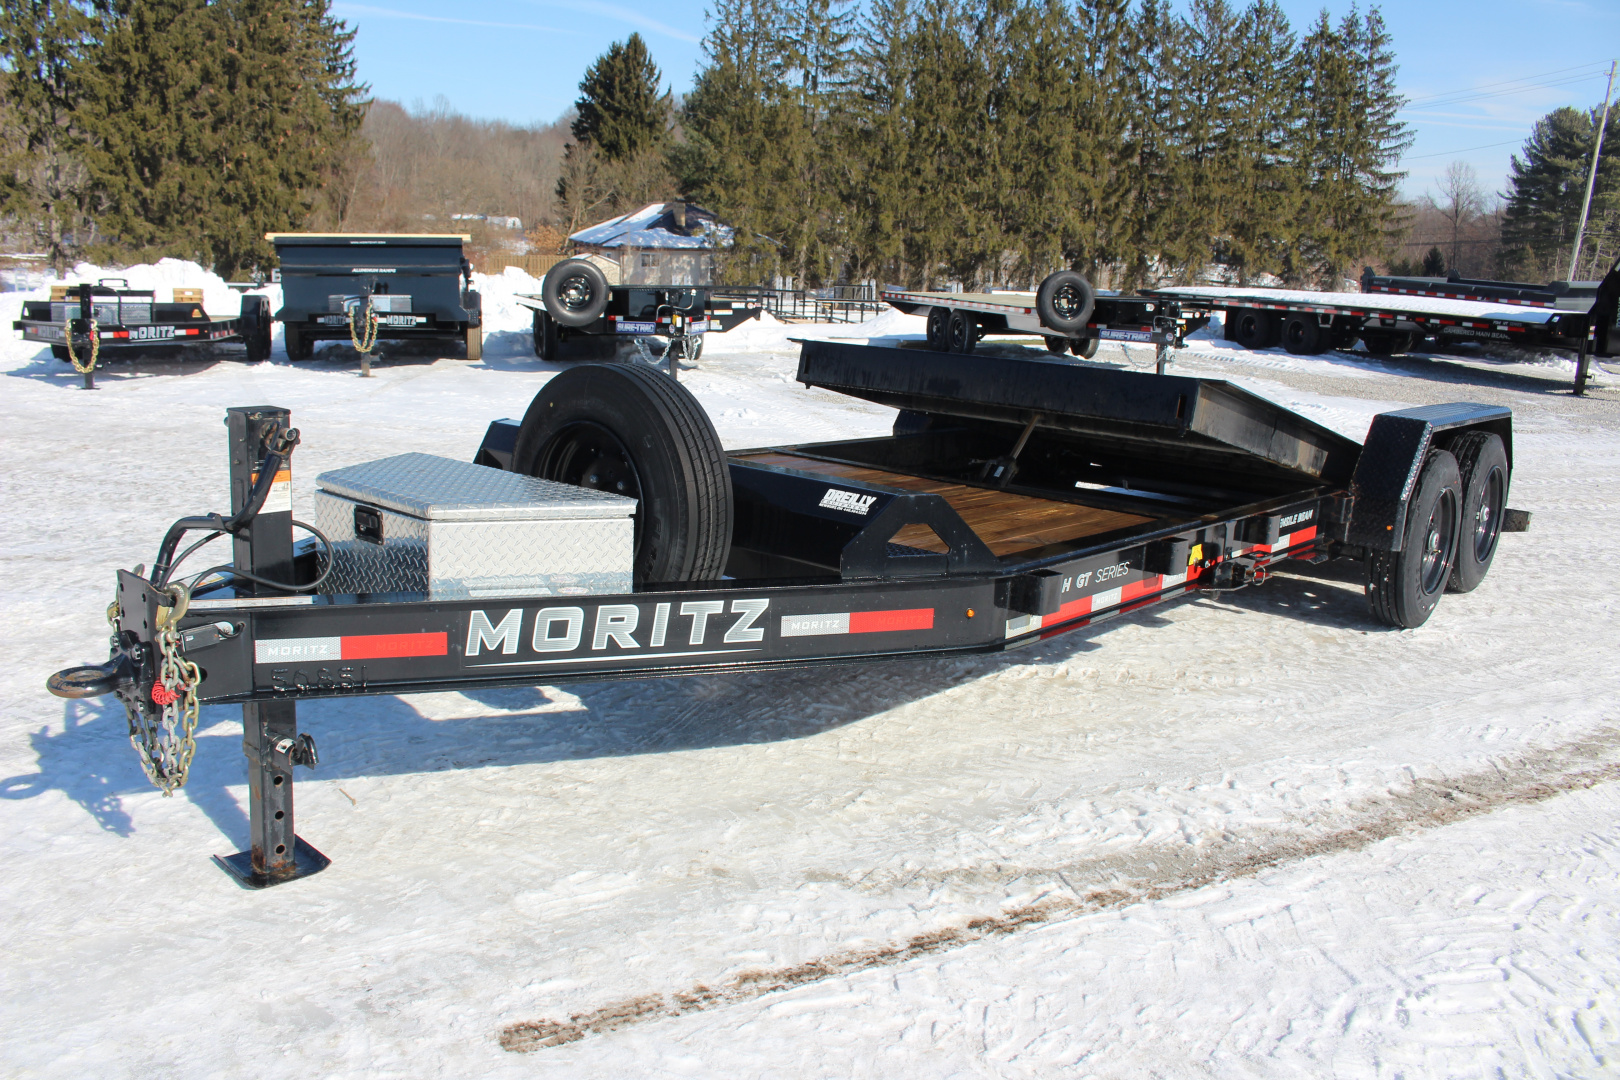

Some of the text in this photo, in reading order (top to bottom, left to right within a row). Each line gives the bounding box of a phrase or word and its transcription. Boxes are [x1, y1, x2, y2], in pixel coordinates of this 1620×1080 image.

[386, 315, 417, 326] MORITZ
[616, 323, 656, 333] SURE-TRAC
[1101, 330, 1151, 341] SURE-TRAC
[1076, 571, 1093, 589] GT
[1095, 561, 1131, 583] SERIES
[1095, 593, 1118, 605] MORITZ
[464, 598, 770, 657] MORITZ
[791, 620, 841, 631] MORITZ
[267, 644, 329, 657] MORITZ
[375, 639, 436, 651] MORITZ
